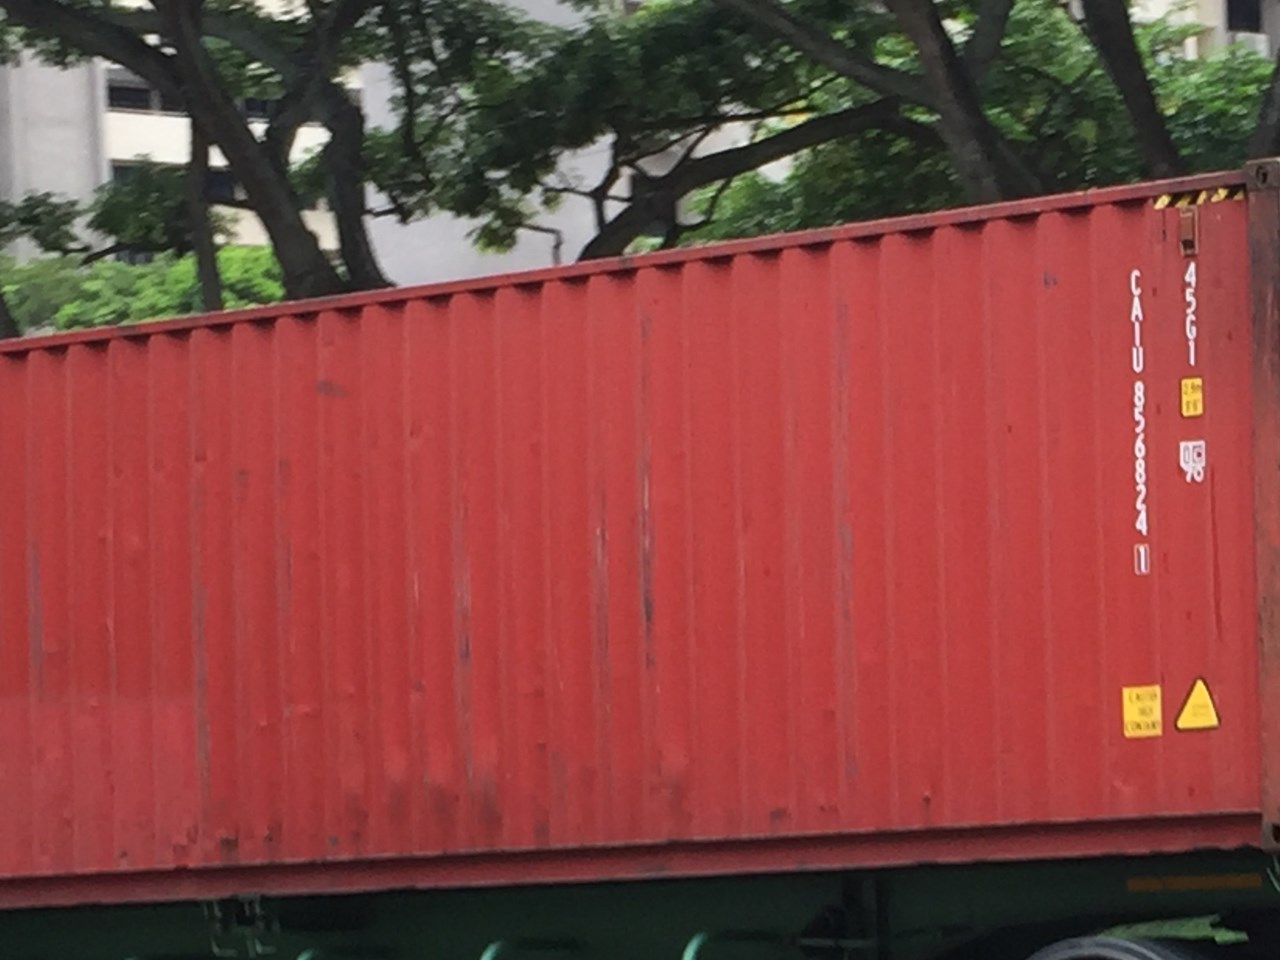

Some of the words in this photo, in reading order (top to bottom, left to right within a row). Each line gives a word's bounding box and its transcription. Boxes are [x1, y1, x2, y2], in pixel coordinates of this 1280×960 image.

[1130, 269, 1144, 374] CAIU
[1184, 261, 1197, 367] 45G1
[1133, 380, 1148, 536] 856824
